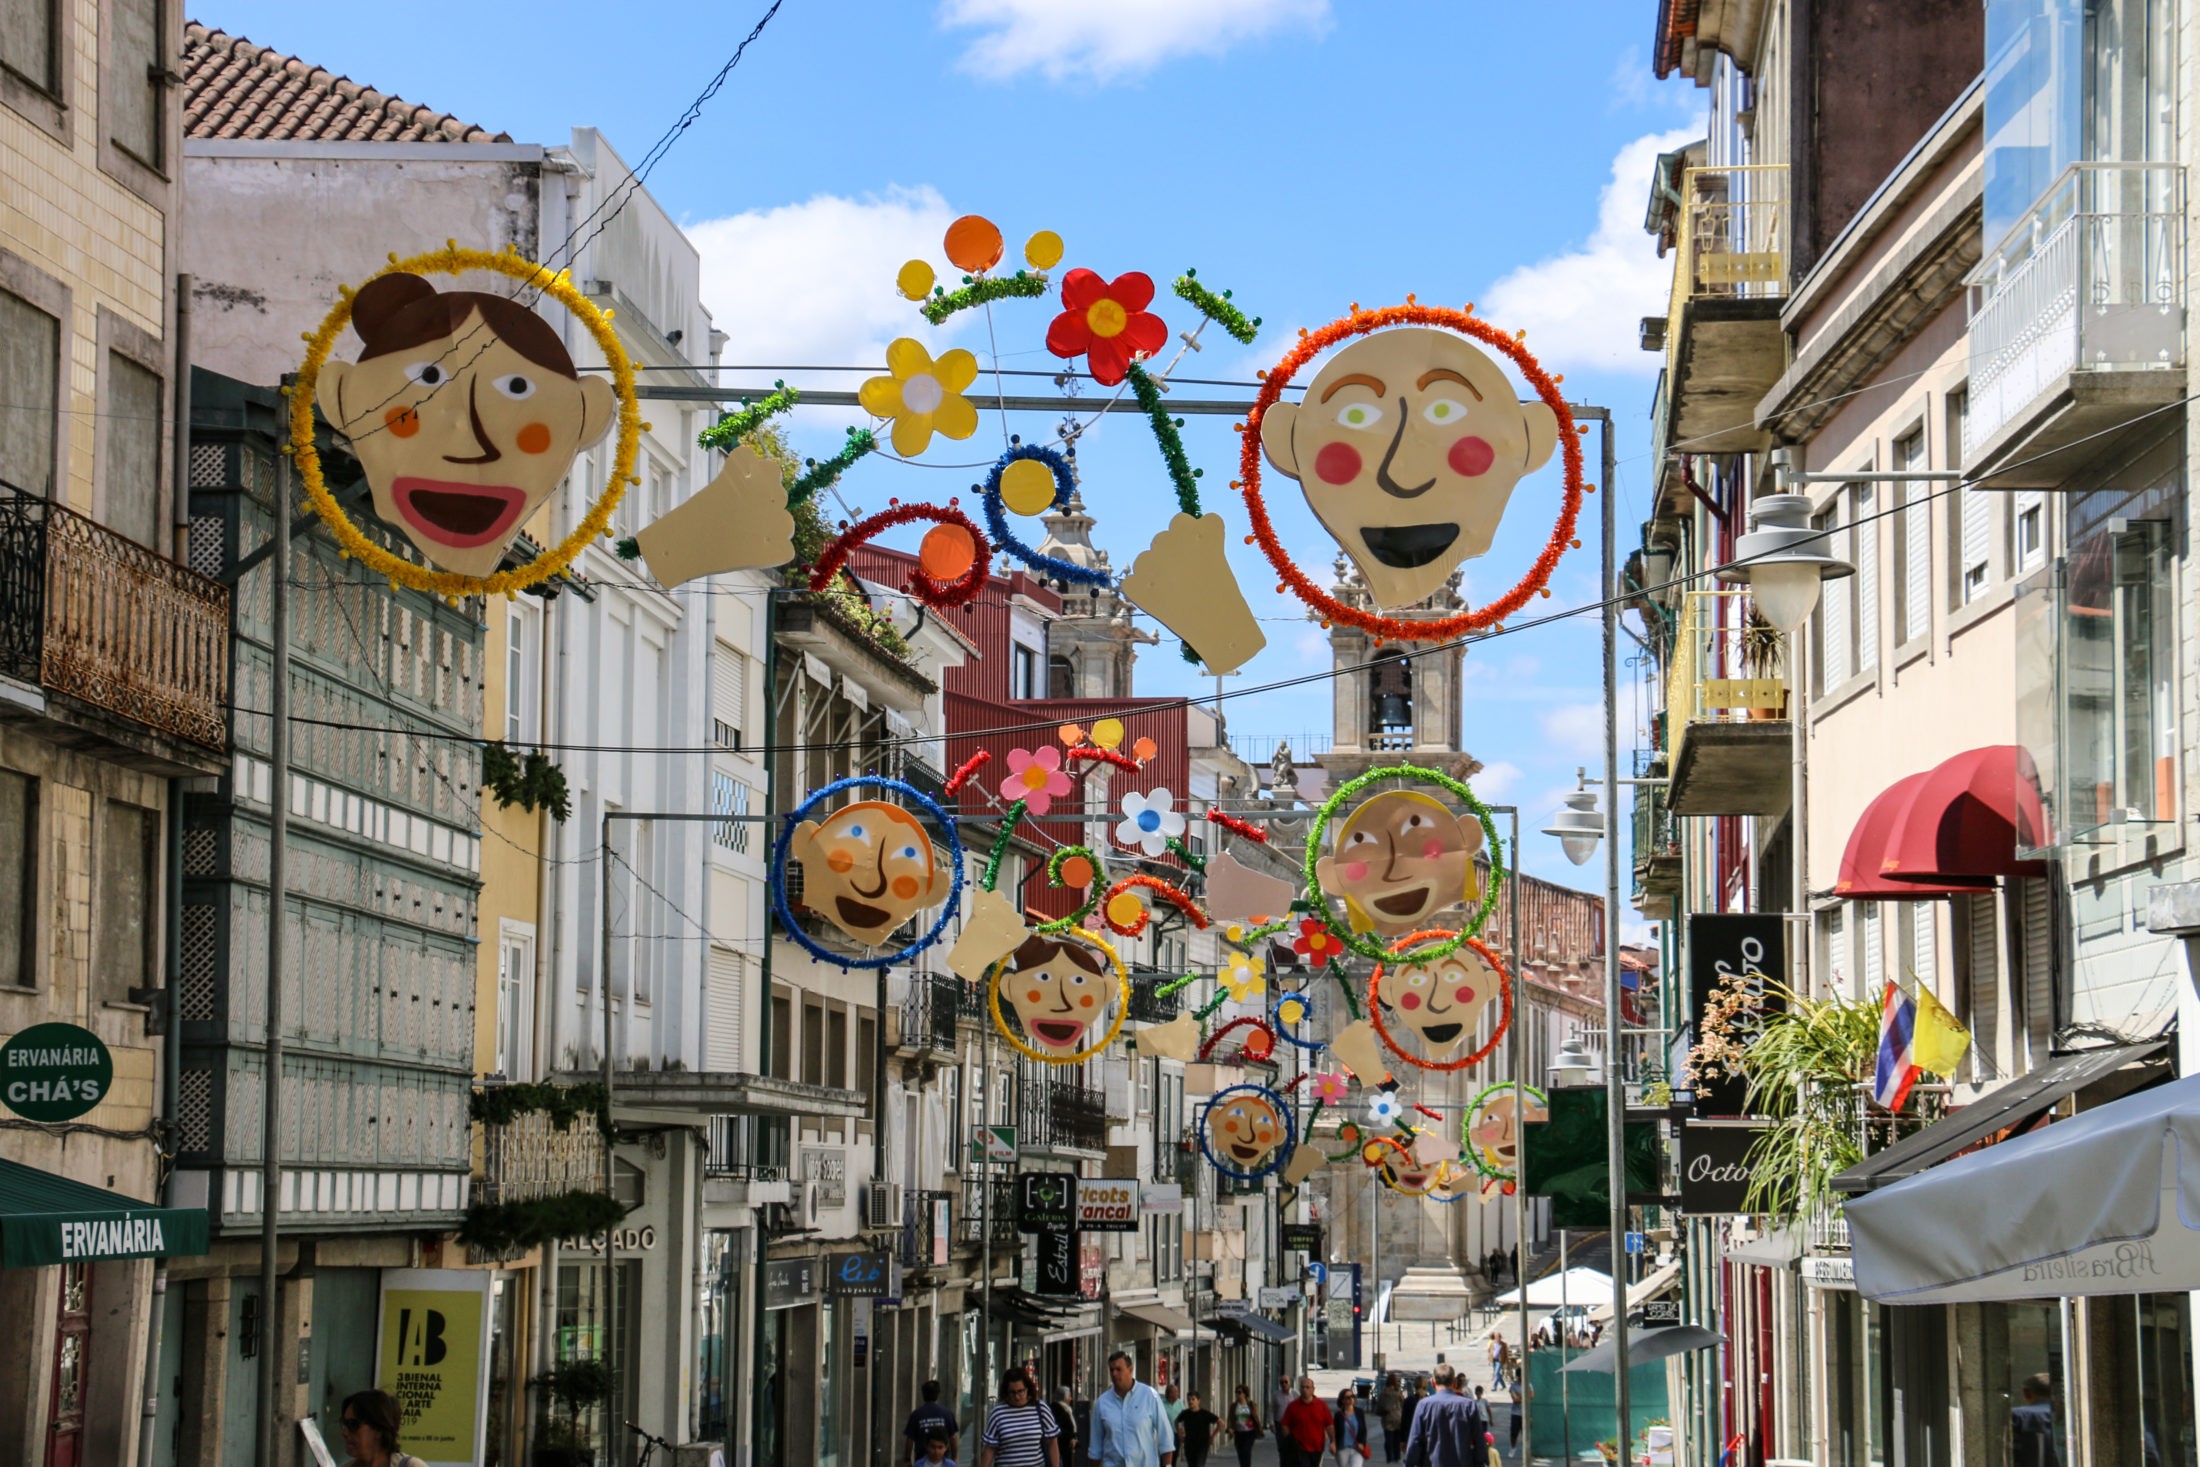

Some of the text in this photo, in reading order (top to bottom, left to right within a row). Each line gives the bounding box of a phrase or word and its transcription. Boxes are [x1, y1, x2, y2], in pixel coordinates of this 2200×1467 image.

[8, 1044, 99, 1067] ERVANÁRIA
[8, 1076, 99, 1103] CHÁ'S
[61, 1212, 164, 1258] ERVANÁRIA
[407, 1400, 432, 1408] ARTE
